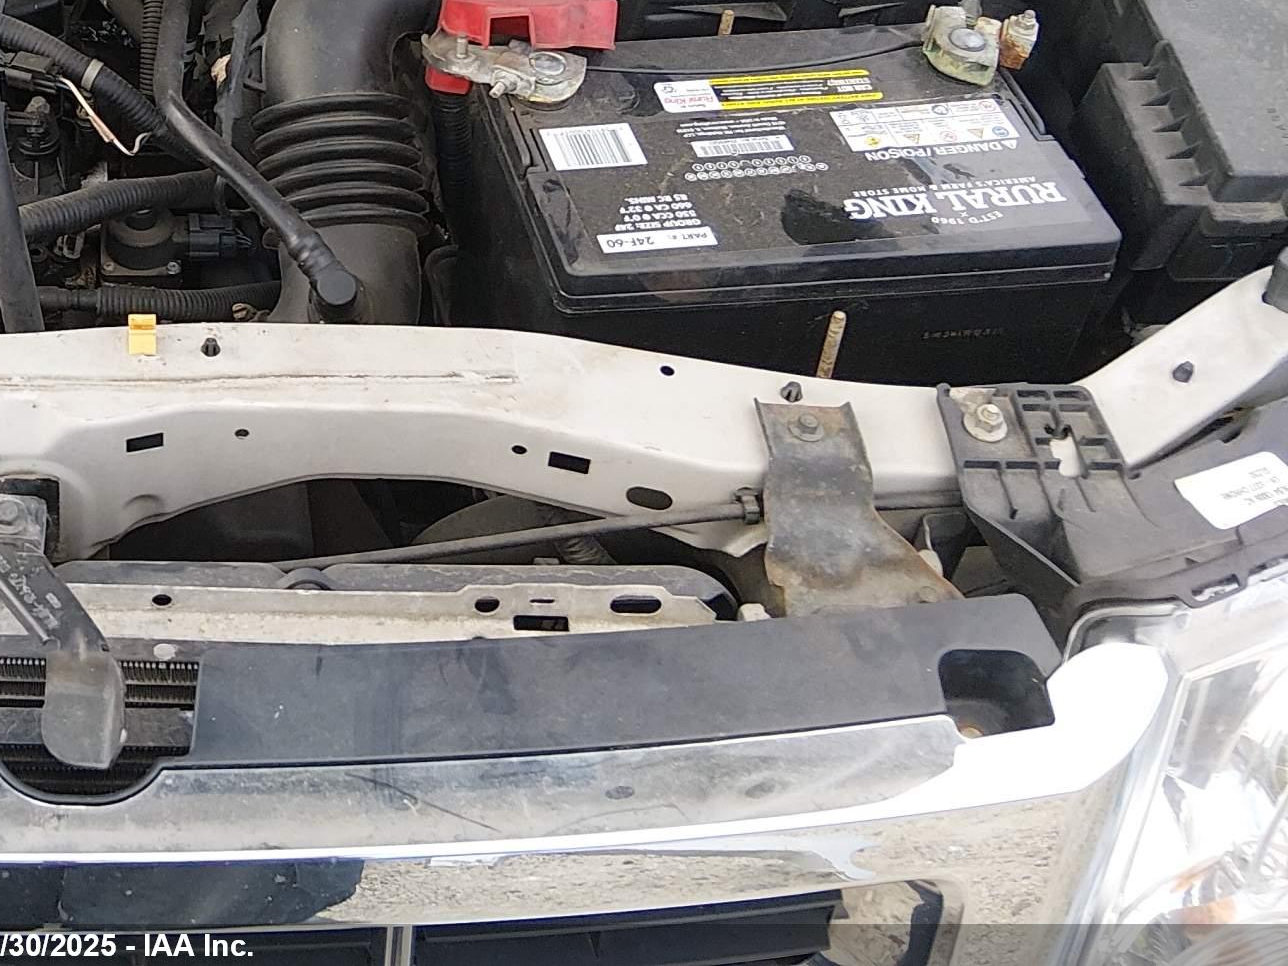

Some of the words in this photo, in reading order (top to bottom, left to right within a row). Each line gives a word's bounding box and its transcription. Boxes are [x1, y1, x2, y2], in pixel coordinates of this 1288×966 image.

[932, 141, 1003, 155] DANGER
[938, 181, 974, 190] FARM
[975, 175, 1037, 188] AMERICA'S
[851, 187, 891, 198] STORE
[892, 185, 926, 194] HOME
[934, 181, 1068, 212] RURAL
[842, 192, 939, 220] KING
[651, 211, 675, 221] CCA
[930, 215, 963, 226] 1960
[662, 218, 702, 229] GROUP
[681, 232, 708, 240] PART
[606, 236, 655, 249] 24F-60
